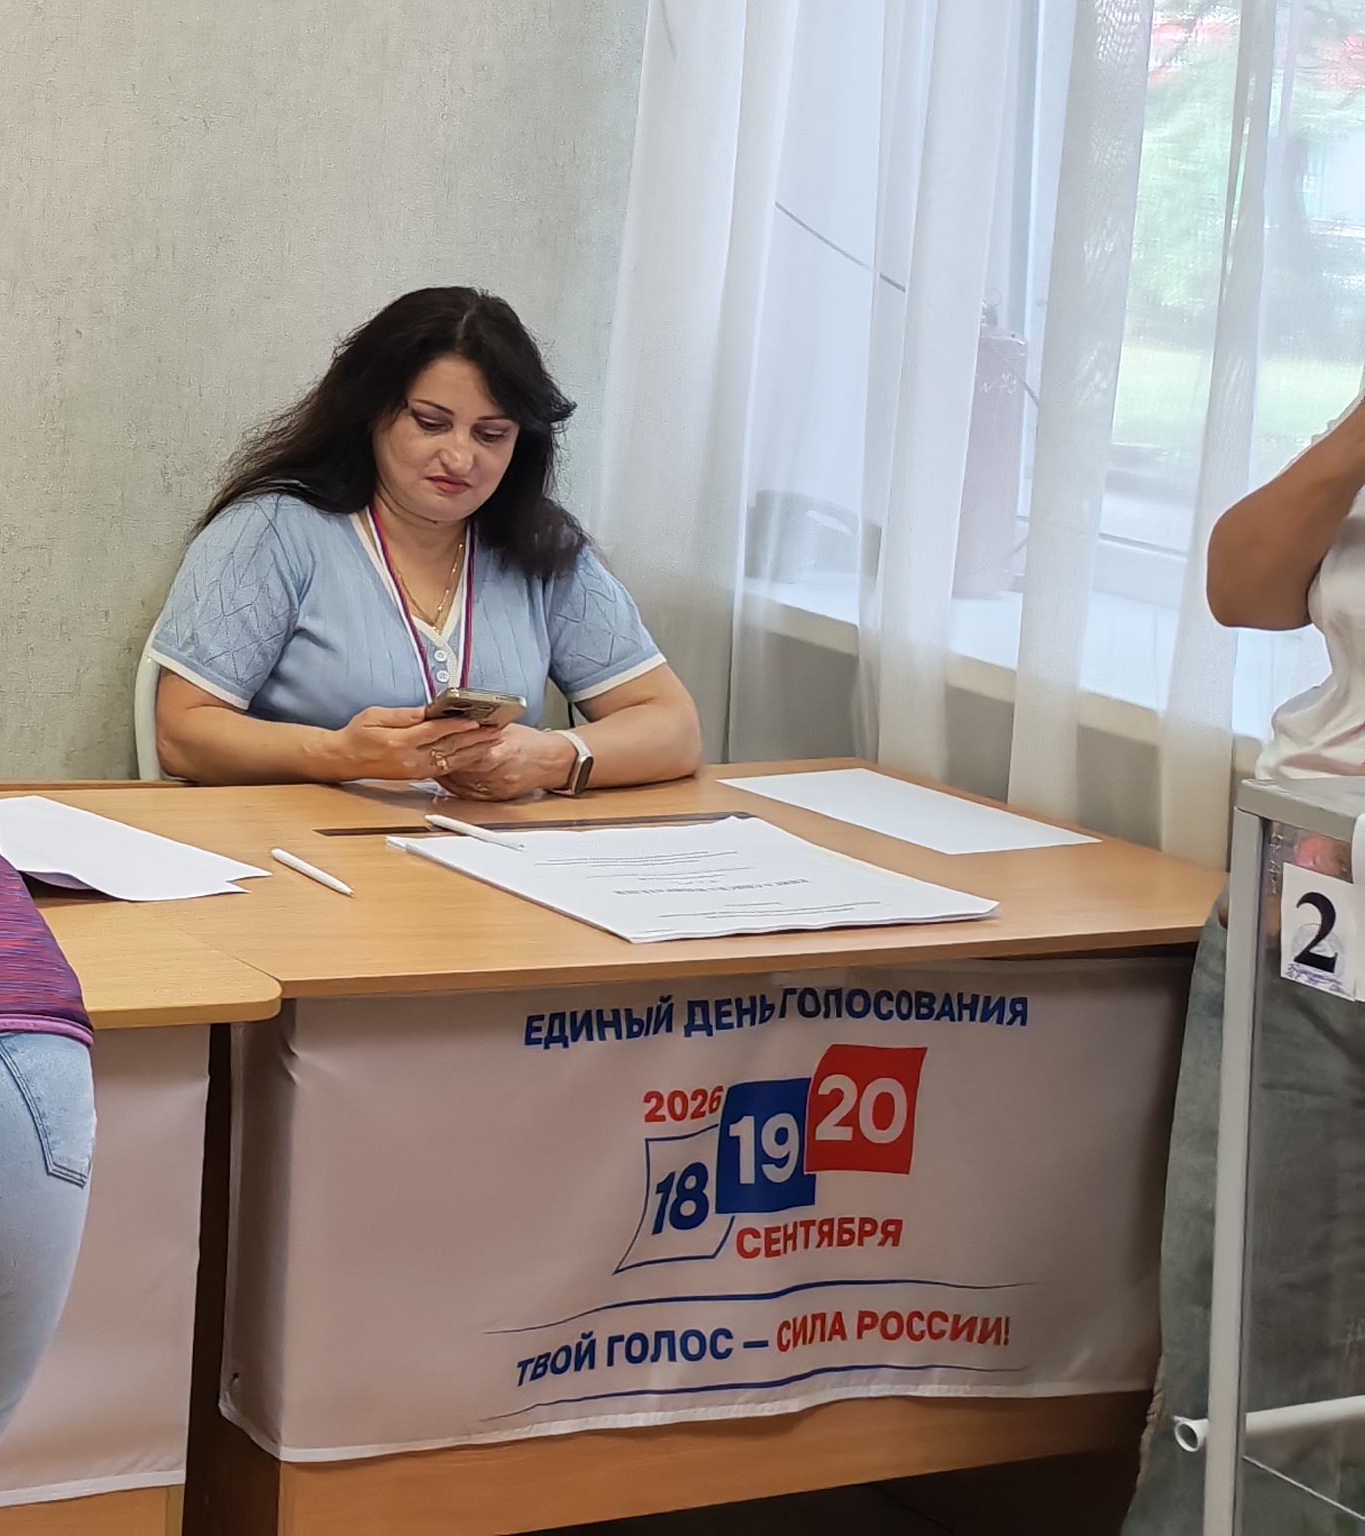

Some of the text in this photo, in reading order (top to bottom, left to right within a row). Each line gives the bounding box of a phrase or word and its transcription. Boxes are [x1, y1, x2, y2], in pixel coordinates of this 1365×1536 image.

[1293, 891, 1339, 974] 2
[523, 987, 1029, 1050] ЕДИНЫЙ ДЕНЬ ГОЛОСОВАНИЯ
[642, 1085, 724, 1123] 2026
[651, 1074, 909, 1235] 18 19 20
[734, 1217, 903, 1261] СЕНТЯБРЯ
[516, 1332, 596, 1386] ТВОЙ
[606, 1327, 733, 1365] ГОЛОС
[776, 1311, 846, 1352] СИЛА
[856, 1309, 1011, 1346] РОССИИ!
